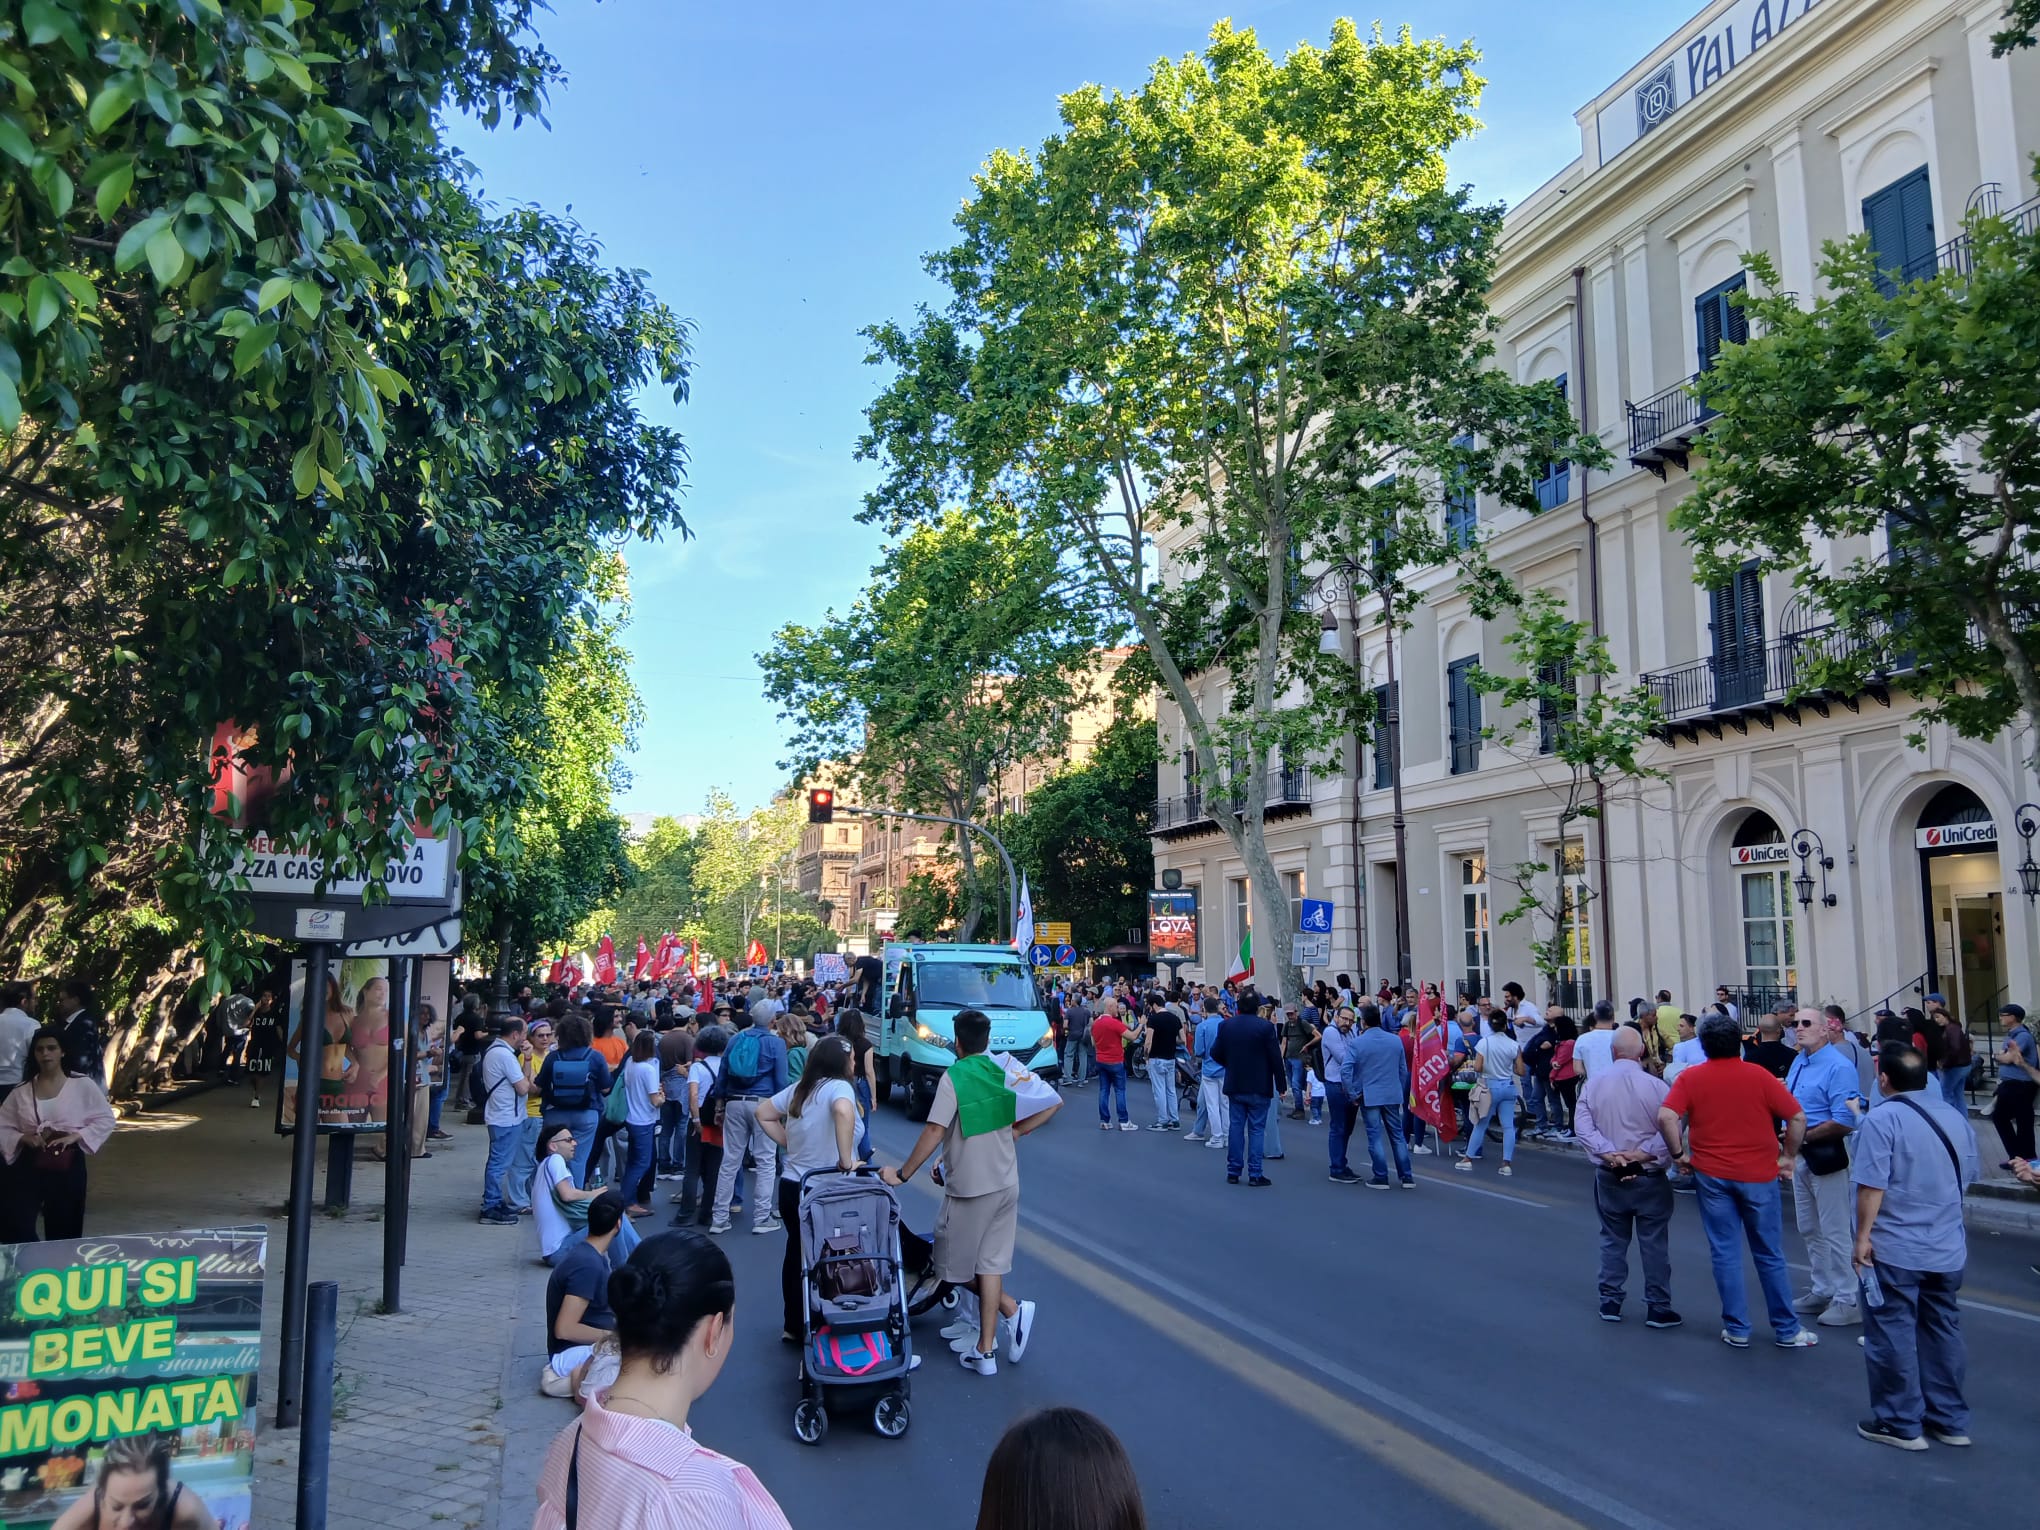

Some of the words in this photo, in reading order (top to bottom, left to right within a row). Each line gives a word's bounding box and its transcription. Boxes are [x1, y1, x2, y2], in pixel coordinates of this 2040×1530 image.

[1151, 920, 1193, 933] LOVA
[20, 1267, 124, 1317] QUI
[142, 1261, 195, 1303] SI
[31, 1320, 174, 1374] BEVE
[0, 1380, 239, 1449] MONATA
